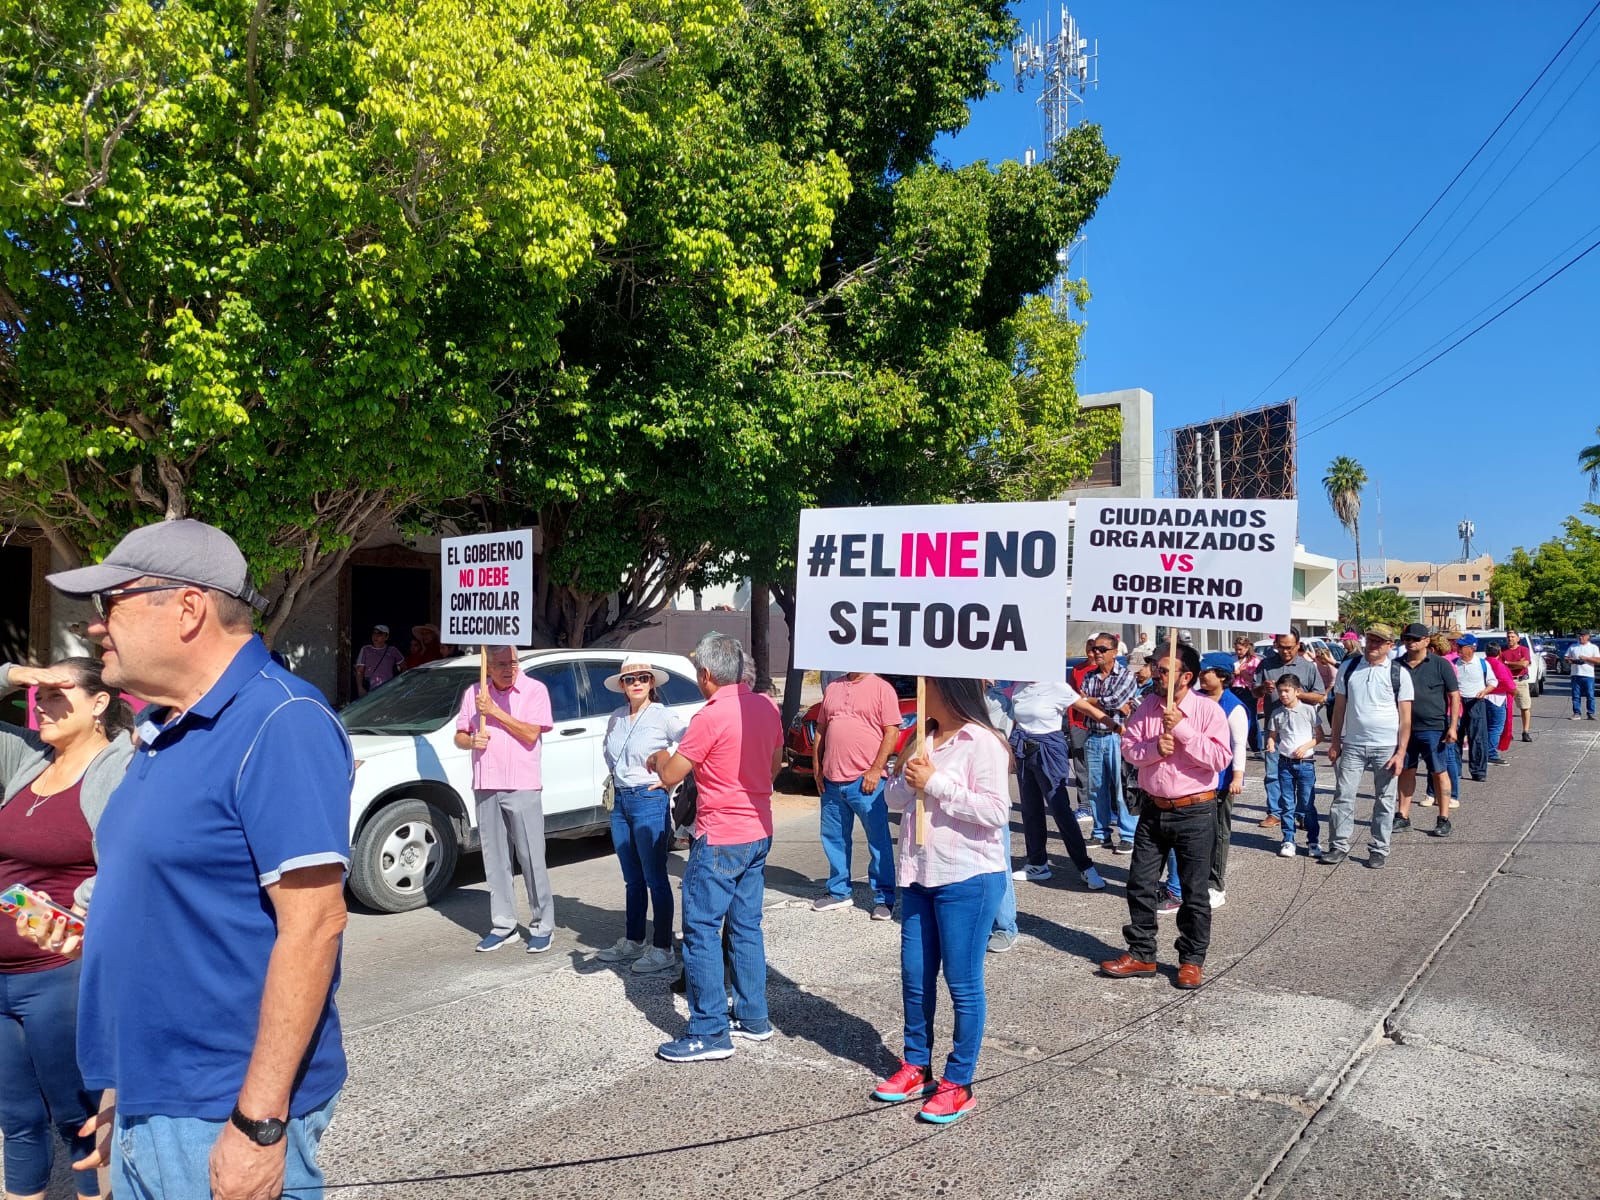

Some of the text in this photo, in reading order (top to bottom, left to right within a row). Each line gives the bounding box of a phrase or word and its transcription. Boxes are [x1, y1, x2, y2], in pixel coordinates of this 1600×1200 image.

[1099, 507, 1267, 529] CIUDADANOS
[1089, 529, 1276, 552] ORGANIZADOS
[447, 540, 524, 565] EL GOBIERNO
[1160, 553, 1194, 573] VS
[459, 566, 510, 588] NO DEBE
[1112, 573, 1243, 598] GOBIERNO
[450, 590, 520, 612] CONTROLAR
[1090, 594, 1264, 623] AUTORITARIO
[449, 616, 520, 636] ELECCIONES
